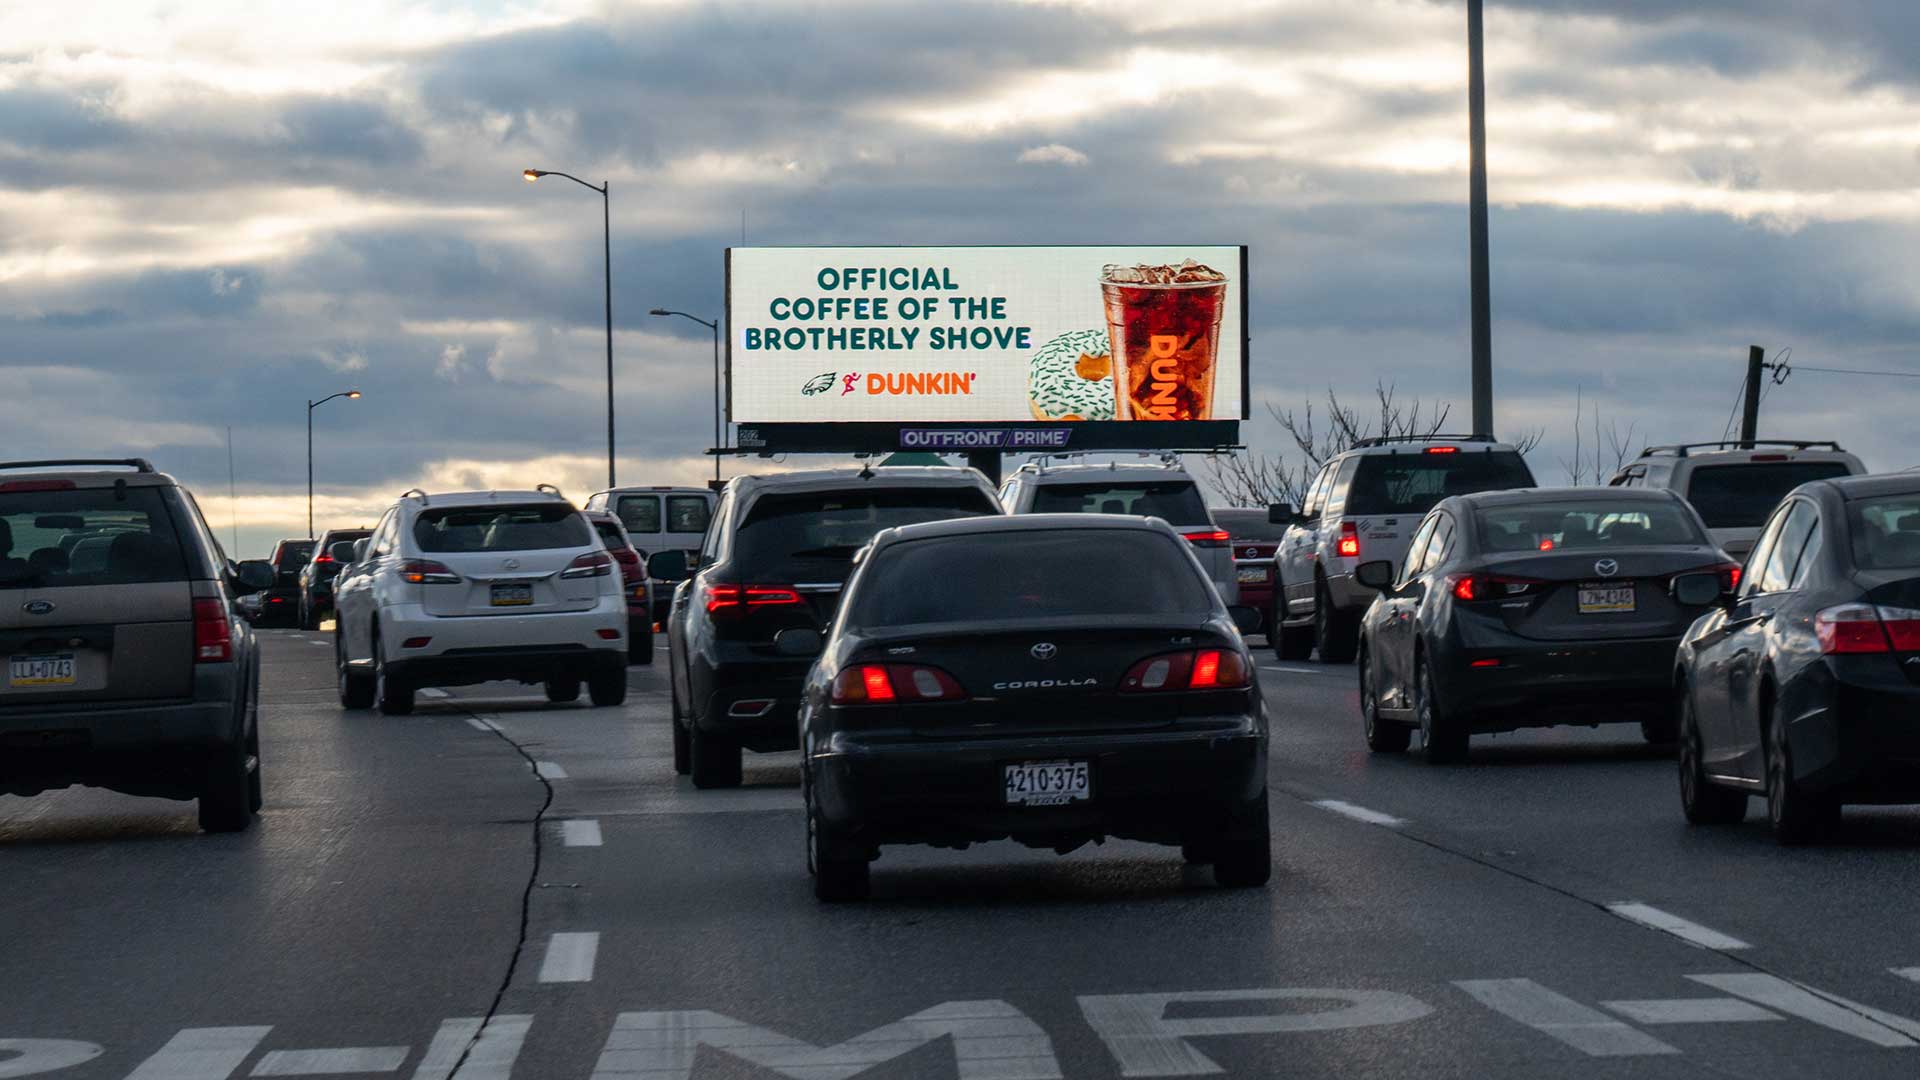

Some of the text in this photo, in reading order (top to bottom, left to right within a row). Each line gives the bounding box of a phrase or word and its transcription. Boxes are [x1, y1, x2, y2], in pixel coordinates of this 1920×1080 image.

[817, 267, 959, 291] OFFICIAL
[770, 297, 1007, 321] COFFEE OF THE
[745, 326, 1031, 350] BROTHERLY SHOVE
[866, 372, 976, 395] DUNKIN'
[904, 431, 1065, 445] OUTFRONT PRIME
[993, 678, 1098, 690] COROLLA
